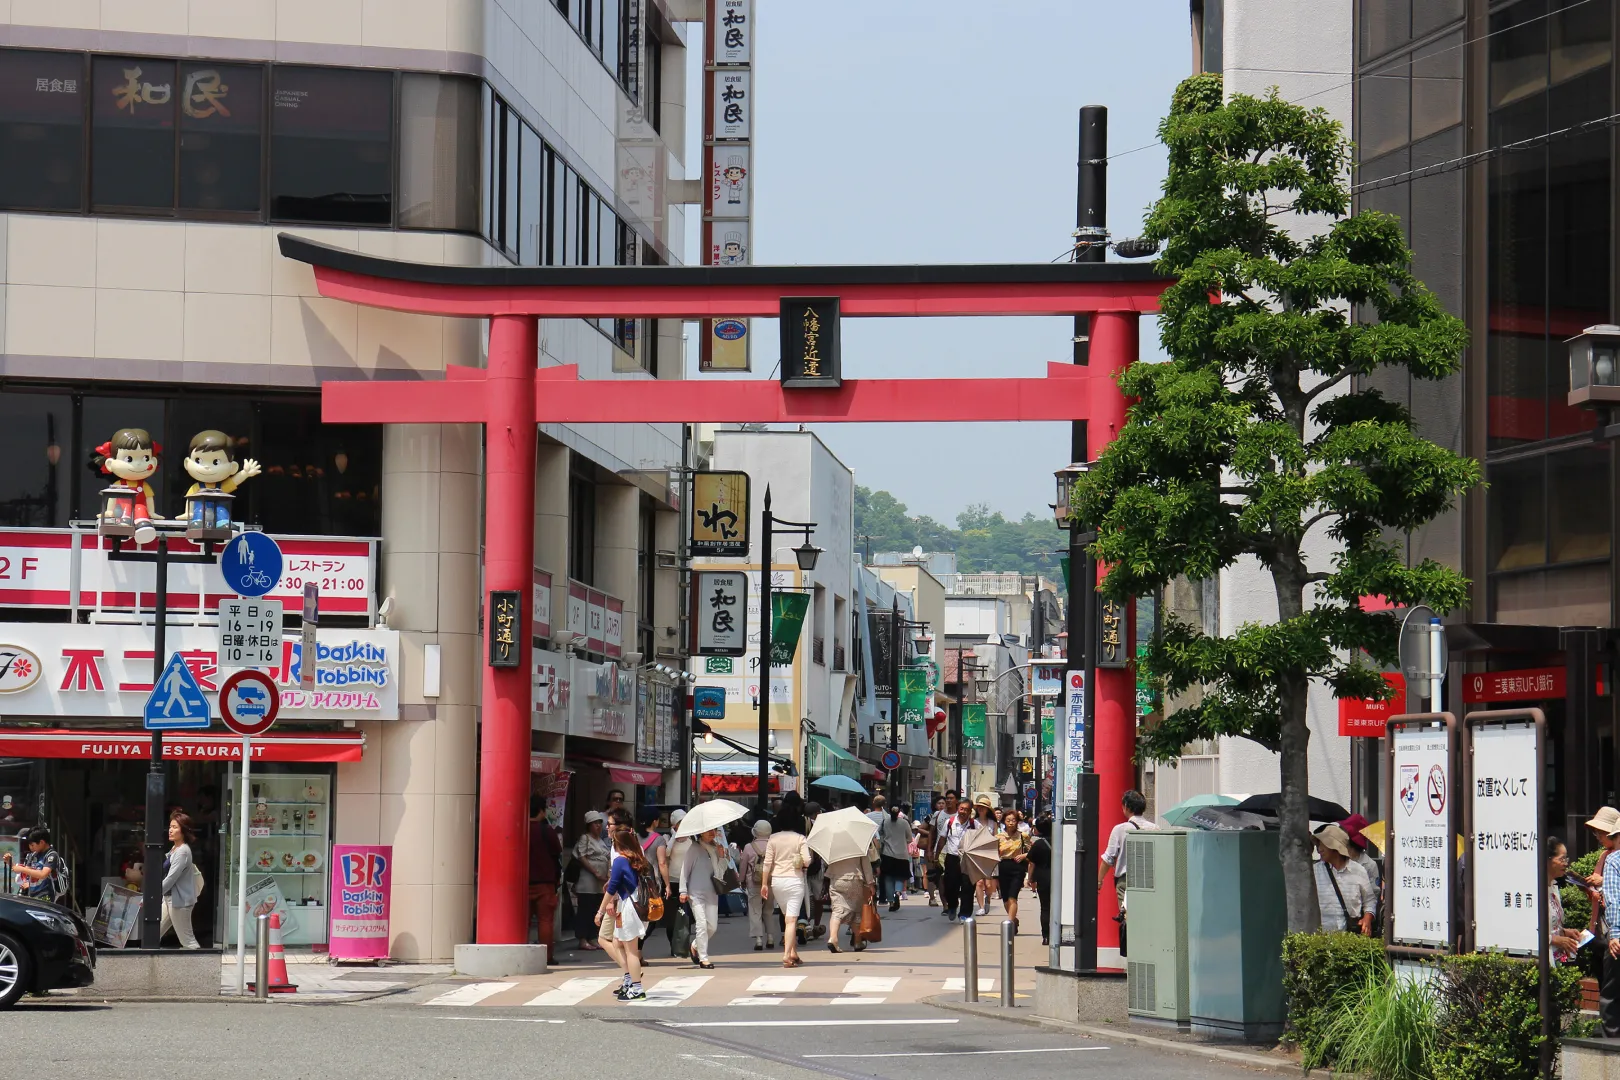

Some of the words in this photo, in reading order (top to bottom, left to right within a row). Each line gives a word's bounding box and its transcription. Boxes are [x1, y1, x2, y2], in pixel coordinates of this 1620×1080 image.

[722, 8, 746, 49] 和民
[36, 77, 77, 94] 居食屋
[112, 66, 231, 118] 和民
[721, 84, 745, 124] 和民
[803, 306, 821, 376] 八幡宮近道
[697, 503, 738, 540] わん
[289, 560, 346, 573] レストラン
[713, 578, 733, 586] 居食屋
[229, 605, 274, 618] 平日の
[710, 587, 736, 633] 和民
[496, 598, 514, 659] 小町通り
[1102, 599, 1121, 660] 小町通り
[316, 667, 388, 686] robbins
[1494, 674, 1554, 694] 三菱東京UFJ銀行
[312, 692, 379, 708] アイスクリーム
[1365, 703, 1385, 711] MUFG
[1347, 718, 1387, 727] 三菱東京UF
[81, 744, 141, 755] FUJIYA
[149, 745, 266, 757] ESTAURAT
[1476, 777, 1528, 797] 放置なくして
[341, 853, 387, 887] BR
[1402, 875, 1441, 889] 安全で美しいまち
[342, 889, 383, 903] baskin
[1411, 895, 1432, 909] かまくら
[1504, 891, 1533, 909] 鎌倉市
[343, 904, 384, 915] robbins
